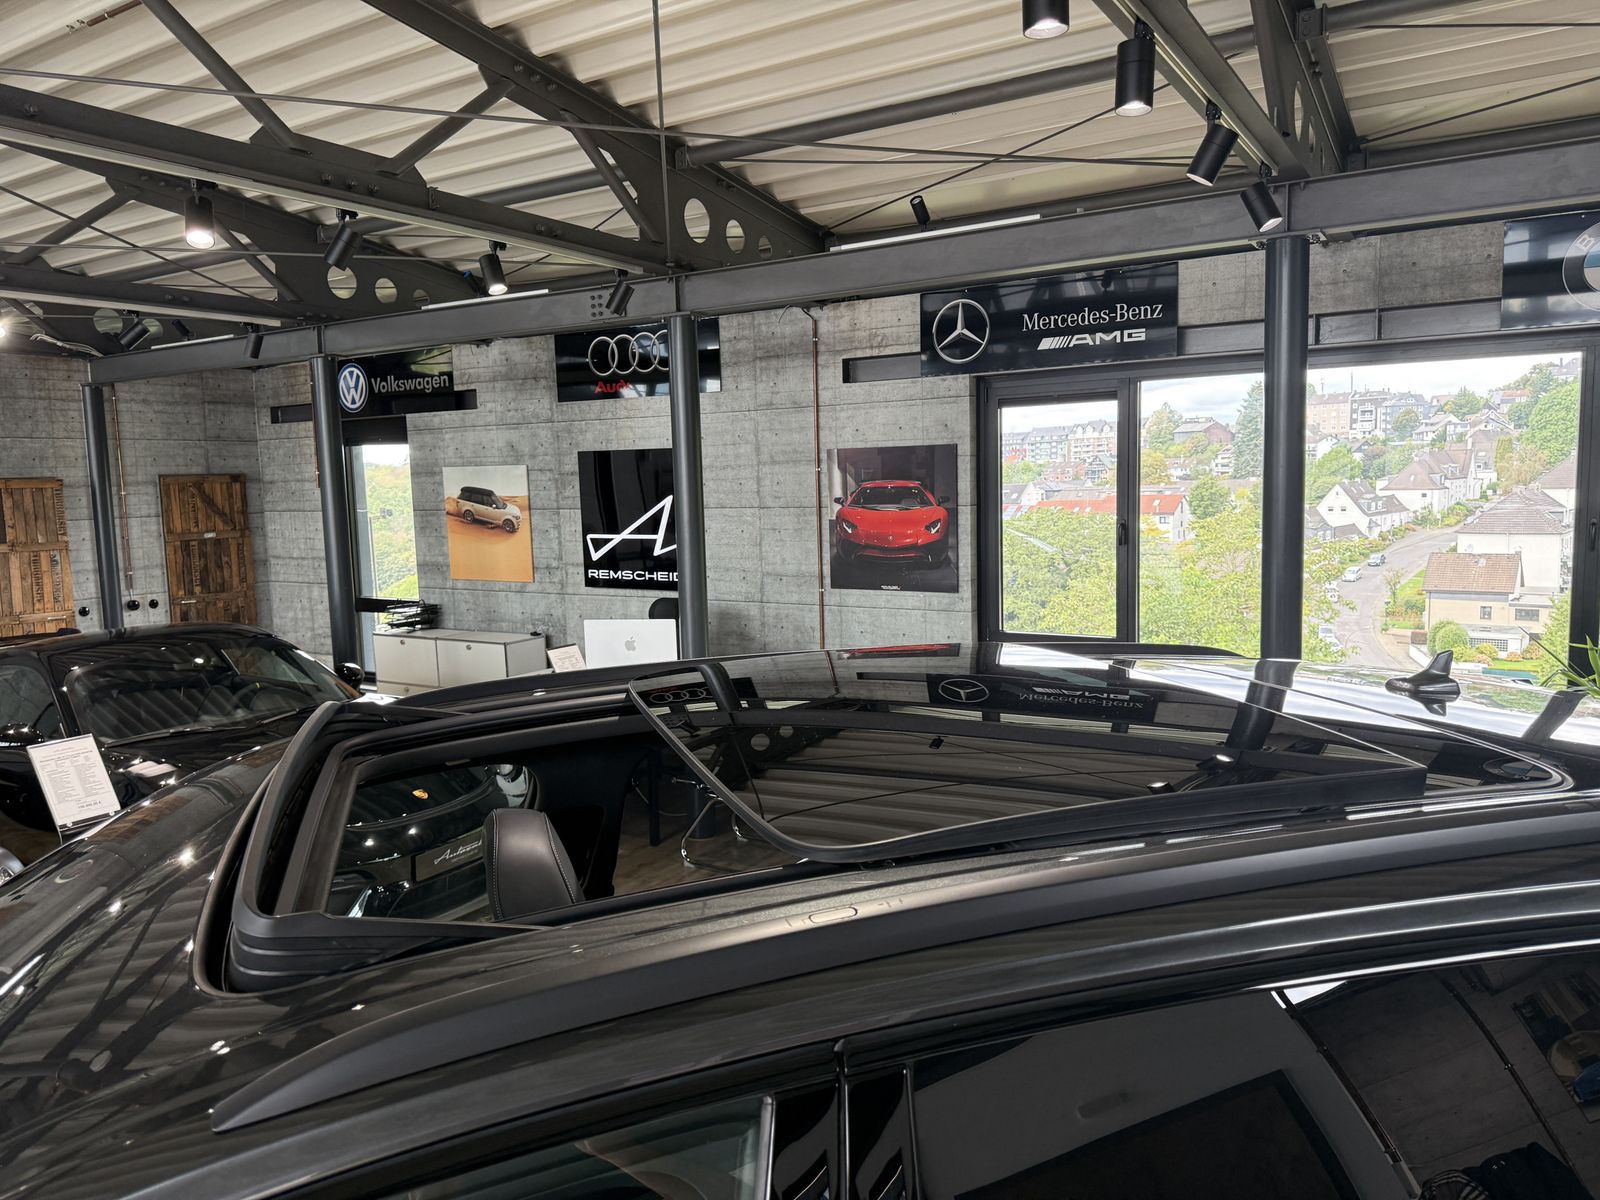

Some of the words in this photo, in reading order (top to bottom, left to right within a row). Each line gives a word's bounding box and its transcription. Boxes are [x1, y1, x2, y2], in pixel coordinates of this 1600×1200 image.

[1021, 303, 1163, 331] Mercedes-Benz
[1068, 328, 1146, 347] AMG
[371, 375, 449, 393] Volkswagen
